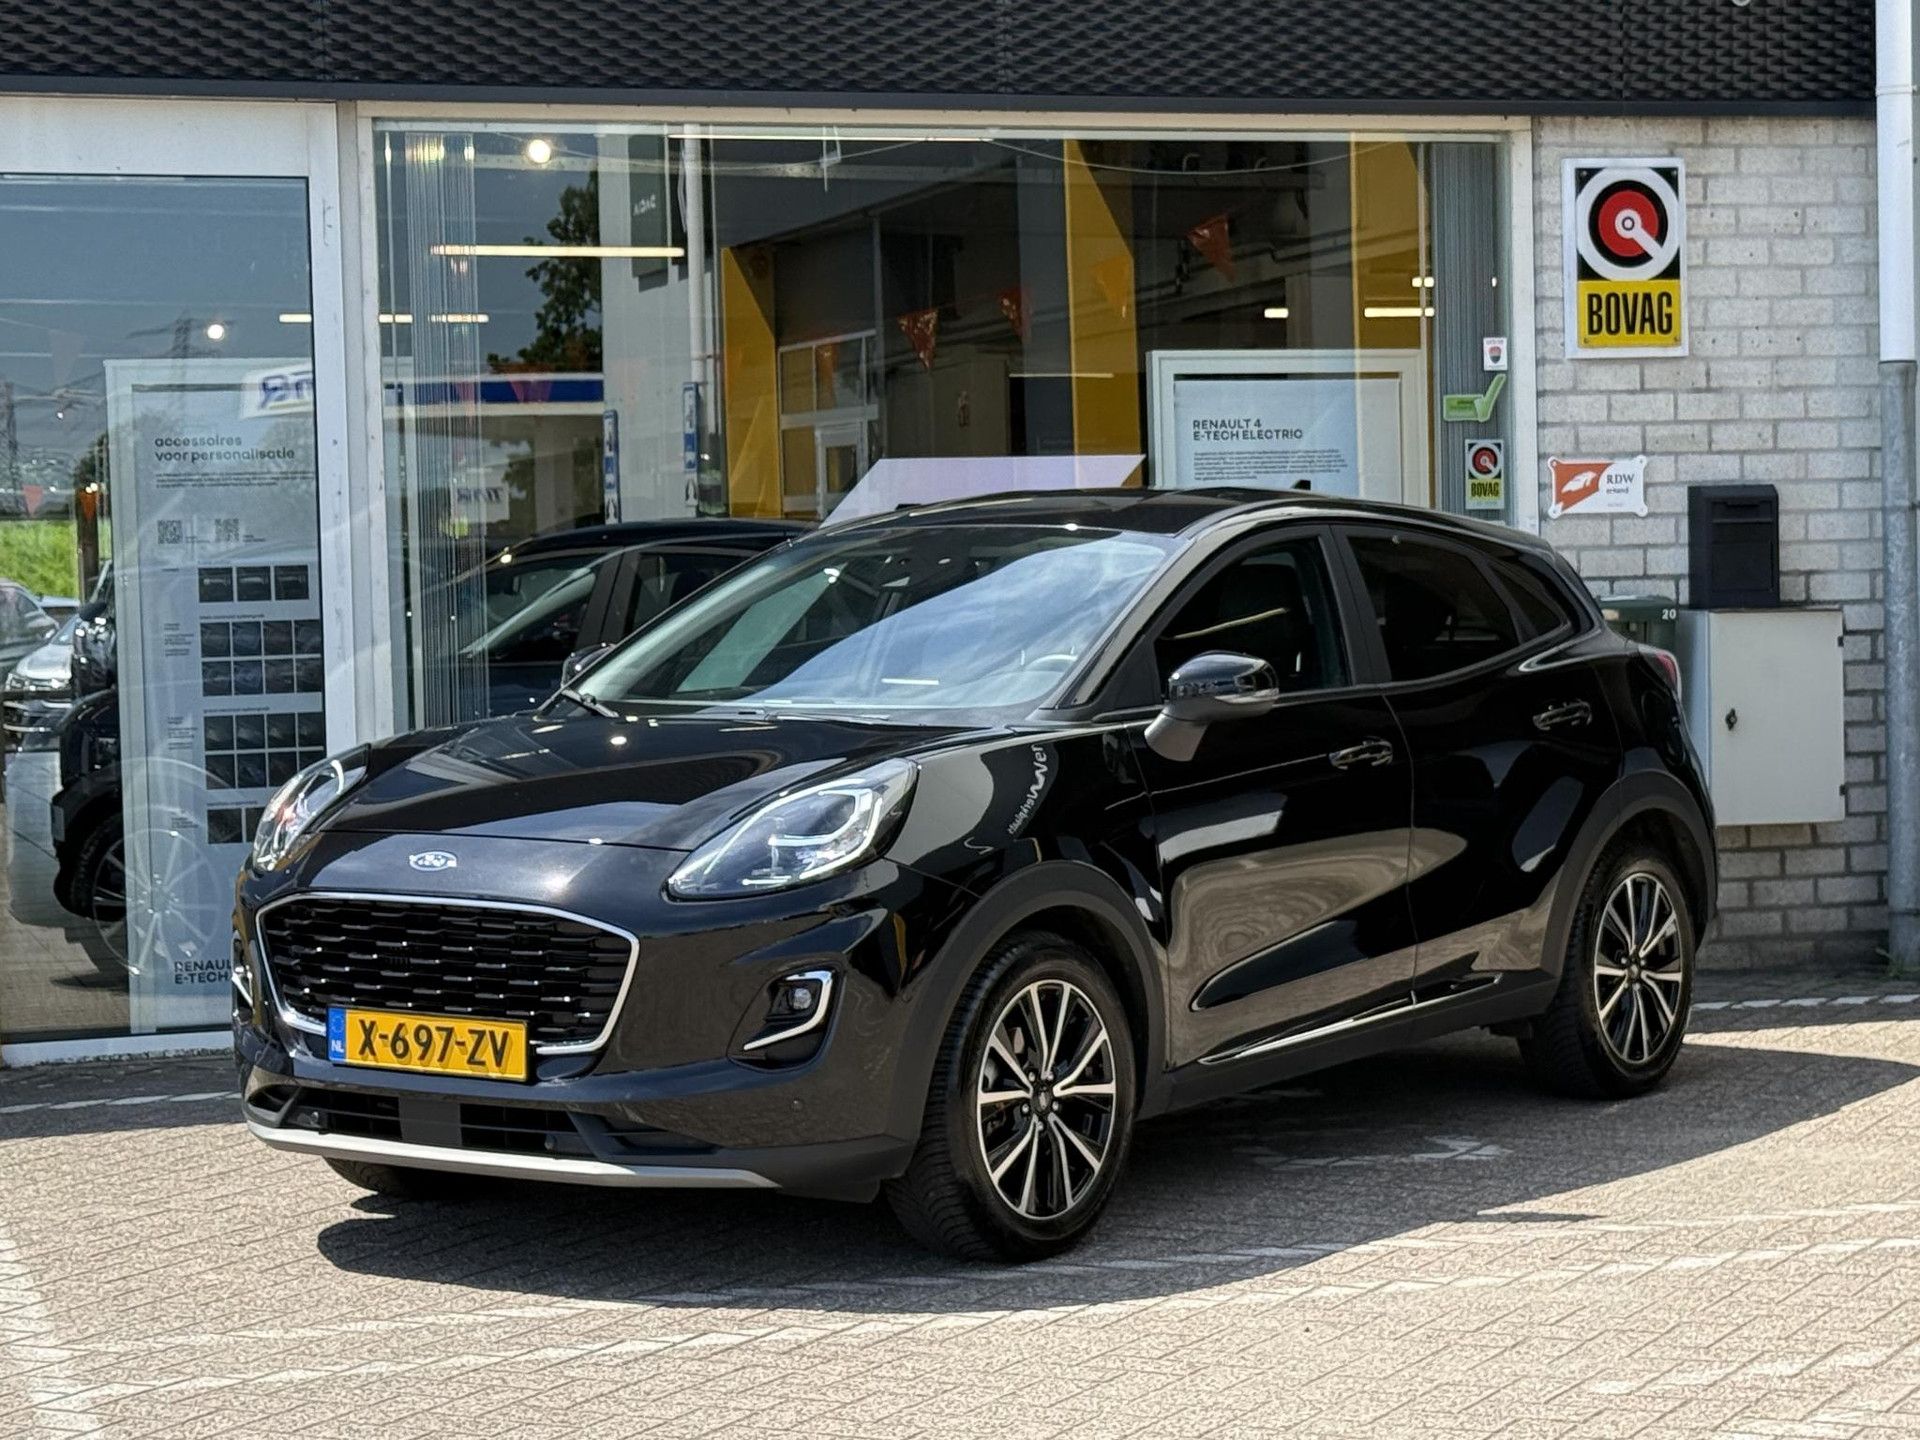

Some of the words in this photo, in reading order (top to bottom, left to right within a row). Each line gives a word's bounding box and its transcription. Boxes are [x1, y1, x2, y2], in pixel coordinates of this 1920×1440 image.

[1587, 291, 1673, 335] BOVAG
[1193, 419, 1251, 429] RENAULT
[1254, 419, 1262, 428] 4
[155, 434, 242, 447] accessoires
[1193, 430, 1239, 441] E-TECH
[1242, 429, 1303, 440] ELECTRIC
[155, 451, 189, 462] voor
[191, 448, 295, 463] personalisatie
[1606, 474, 1634, 484] RDW
[1471, 482, 1499, 497] BOVAG
[1662, 609, 1677, 620] 20
[175, 960, 231, 972] RENAUL
[175, 972, 228, 984] E-TECH
[331, 1039, 345, 1053] NL
[358, 1019, 509, 1068] X-697-ZV
